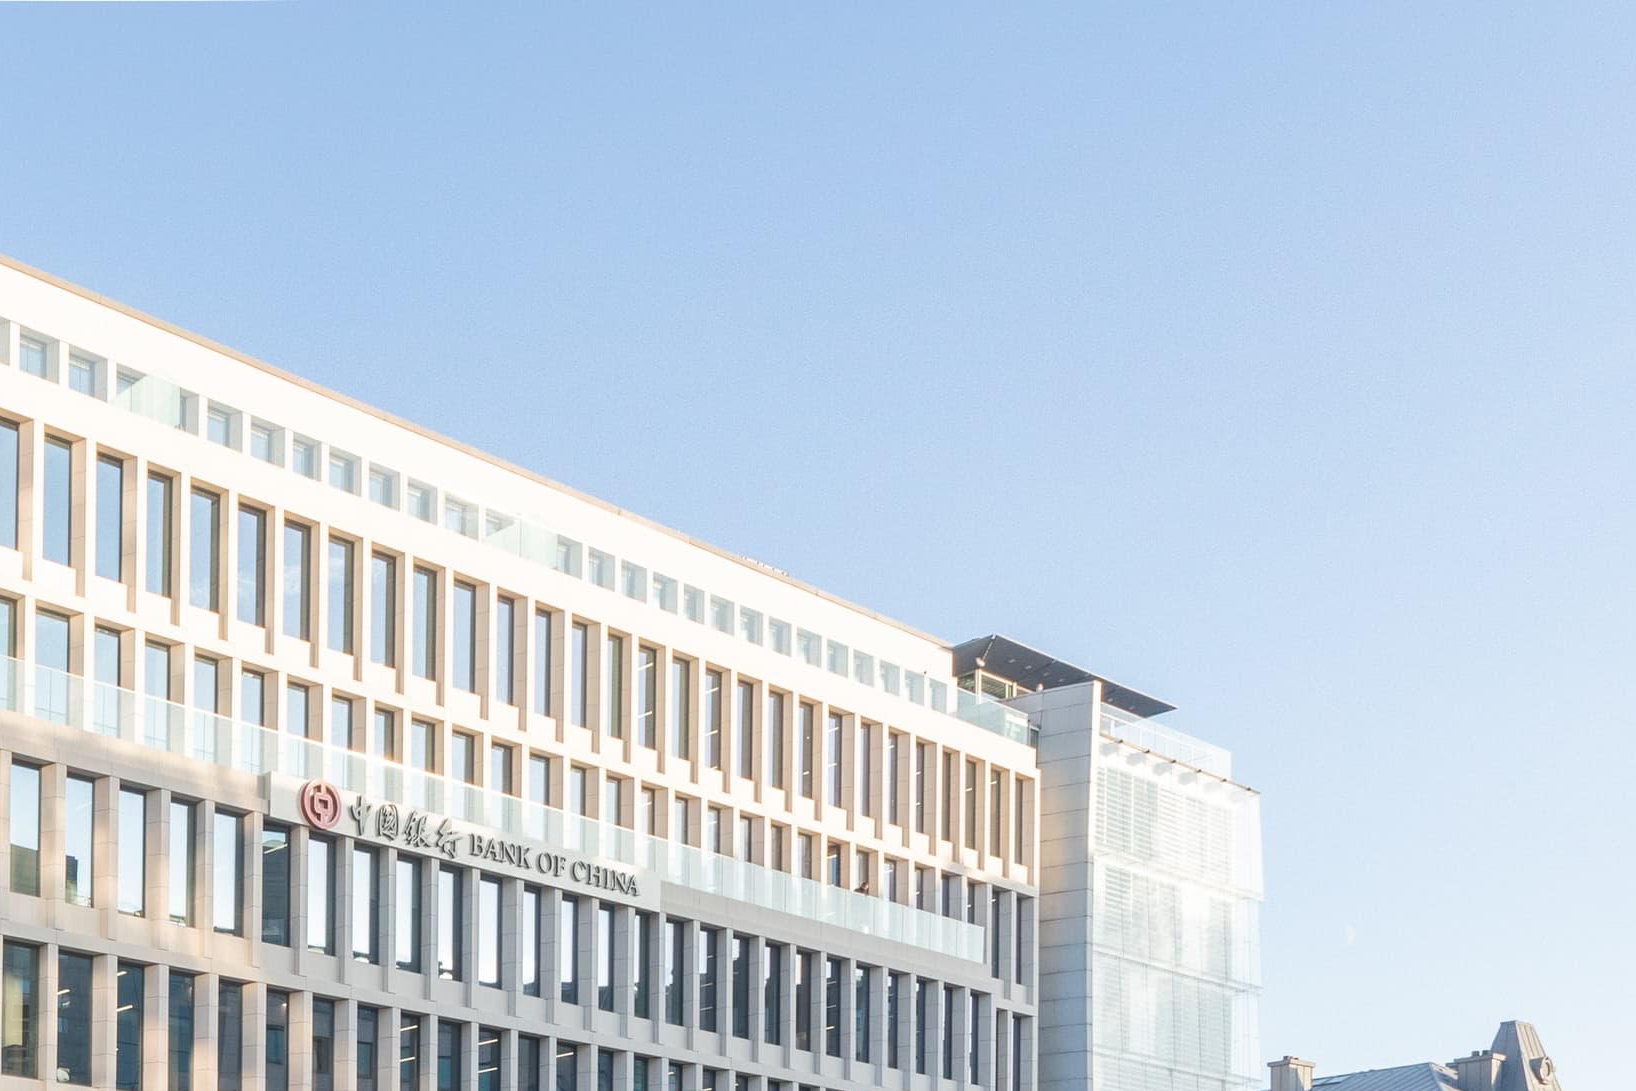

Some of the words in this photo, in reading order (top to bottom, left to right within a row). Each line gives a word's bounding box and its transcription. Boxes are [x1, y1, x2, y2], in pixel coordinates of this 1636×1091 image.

[468, 833, 530, 869] BANK
[535, 850, 566, 877] OF
[570, 860, 641, 897] CHINA
